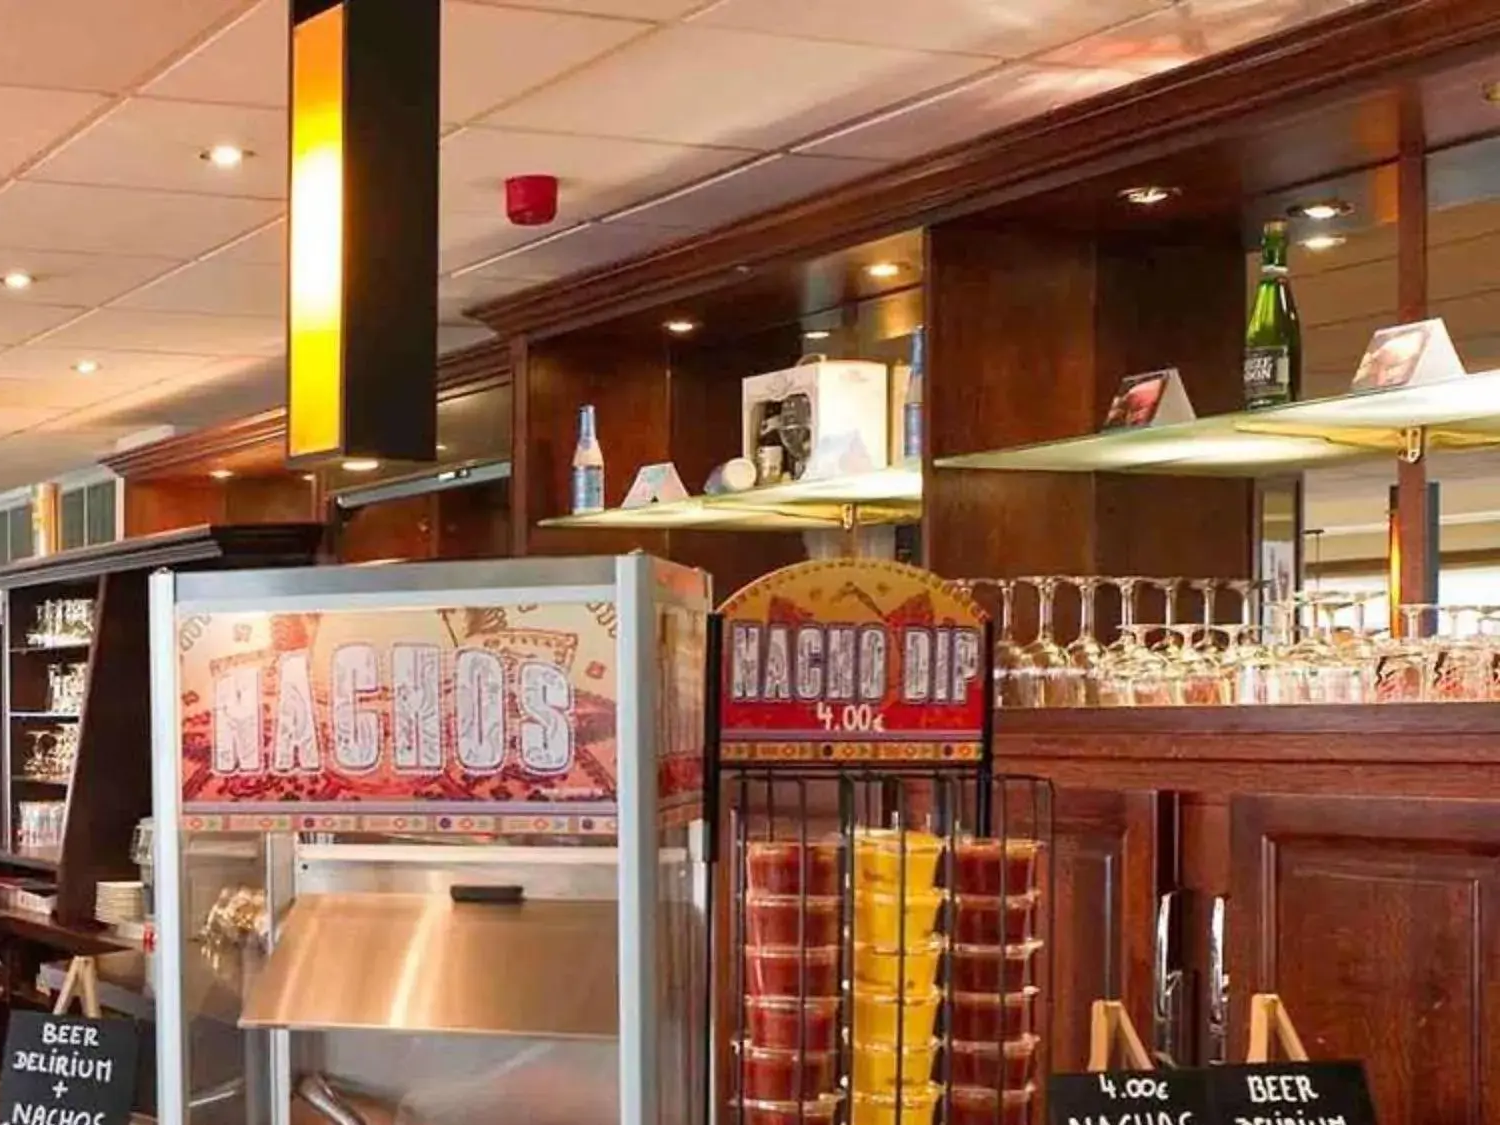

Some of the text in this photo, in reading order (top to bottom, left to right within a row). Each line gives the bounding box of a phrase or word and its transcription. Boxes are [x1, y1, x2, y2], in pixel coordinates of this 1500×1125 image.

[731, 625, 980, 701] NACHO DIP
[211, 642, 575, 776] NACHOS
[42, 1022, 100, 1047] BEER
[1099, 1073, 1170, 1101] 4.00€
[1247, 1075, 1319, 1102] BEER
